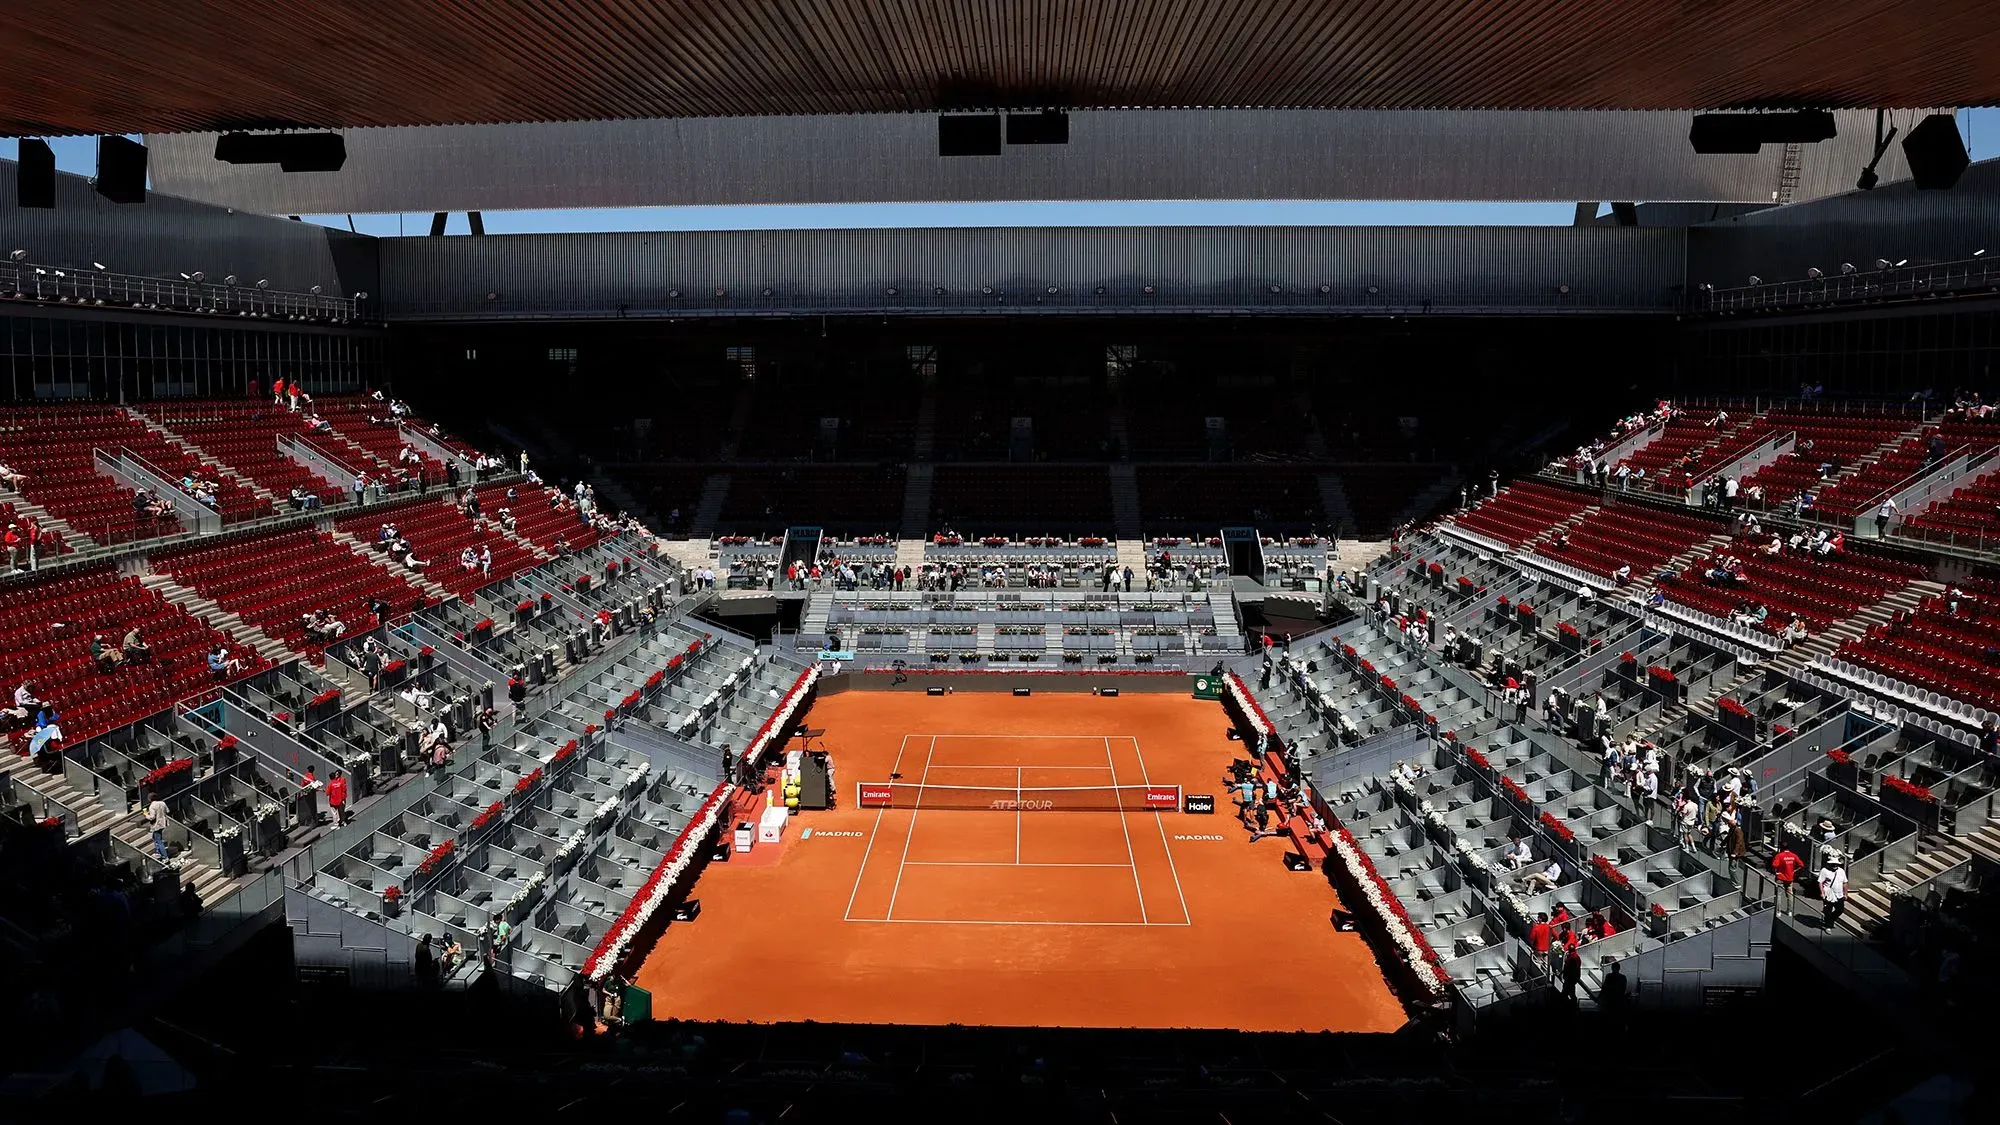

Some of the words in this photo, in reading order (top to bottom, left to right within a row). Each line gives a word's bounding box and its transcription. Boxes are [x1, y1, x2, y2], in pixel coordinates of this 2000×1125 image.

[1147, 793, 1176, 801] Emirates
[990, 799, 1018, 810] ATP
[1020, 799, 1054, 810] TOUR
[1188, 802, 1212, 811] Haier
